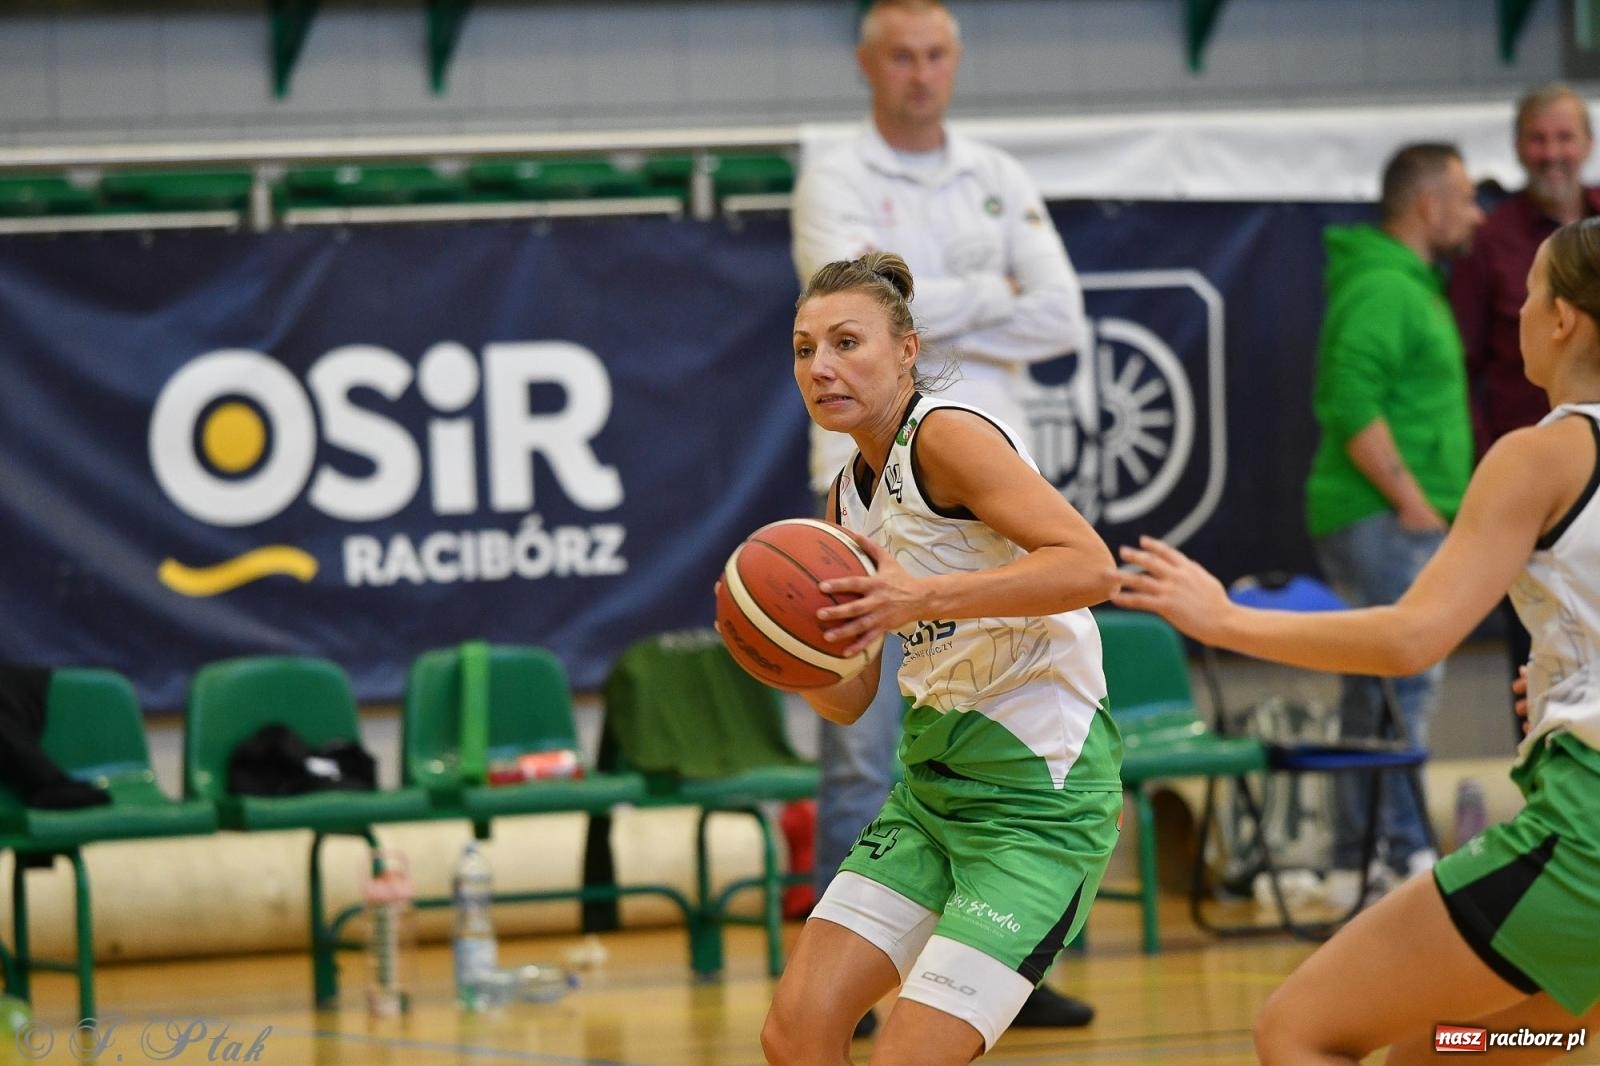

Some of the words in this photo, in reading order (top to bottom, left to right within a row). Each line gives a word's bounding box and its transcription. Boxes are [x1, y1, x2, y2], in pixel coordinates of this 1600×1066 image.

[149, 341, 624, 526] OSiR
[342, 515, 627, 586] RACIBÓRZ
[921, 970, 977, 996] COLO
